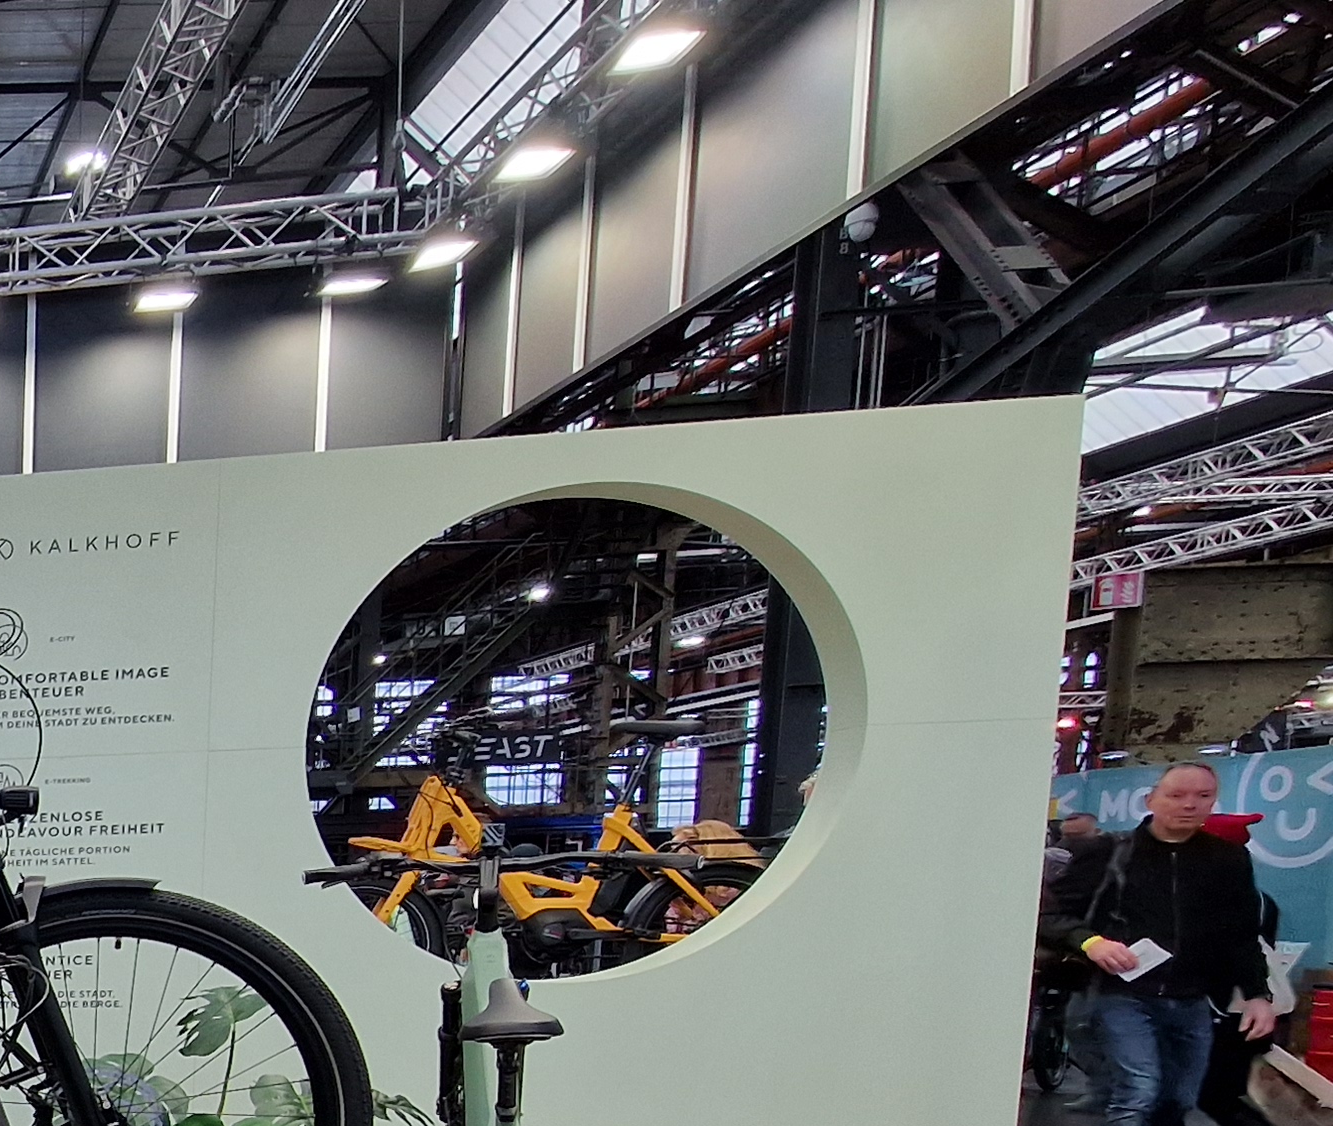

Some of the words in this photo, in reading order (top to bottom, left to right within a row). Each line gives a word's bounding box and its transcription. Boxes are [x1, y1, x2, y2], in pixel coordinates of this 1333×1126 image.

[29, 531, 181, 555] KALKHOFF
[49, 635, 76, 643] E-CITY
[115, 666, 170, 680] IMAGE
[7, 719, 41, 729] DEINE
[45, 717, 79, 727] STADT
[82, 717, 98, 726] ZU
[101, 713, 175, 725] ENTDECKEN.
[89, 823, 165, 836] FREIHEIT
[19, 846, 75, 857] TÄGLICHE
[79, 845, 131, 855] PORTION
[35, 858, 49, 867] IM
